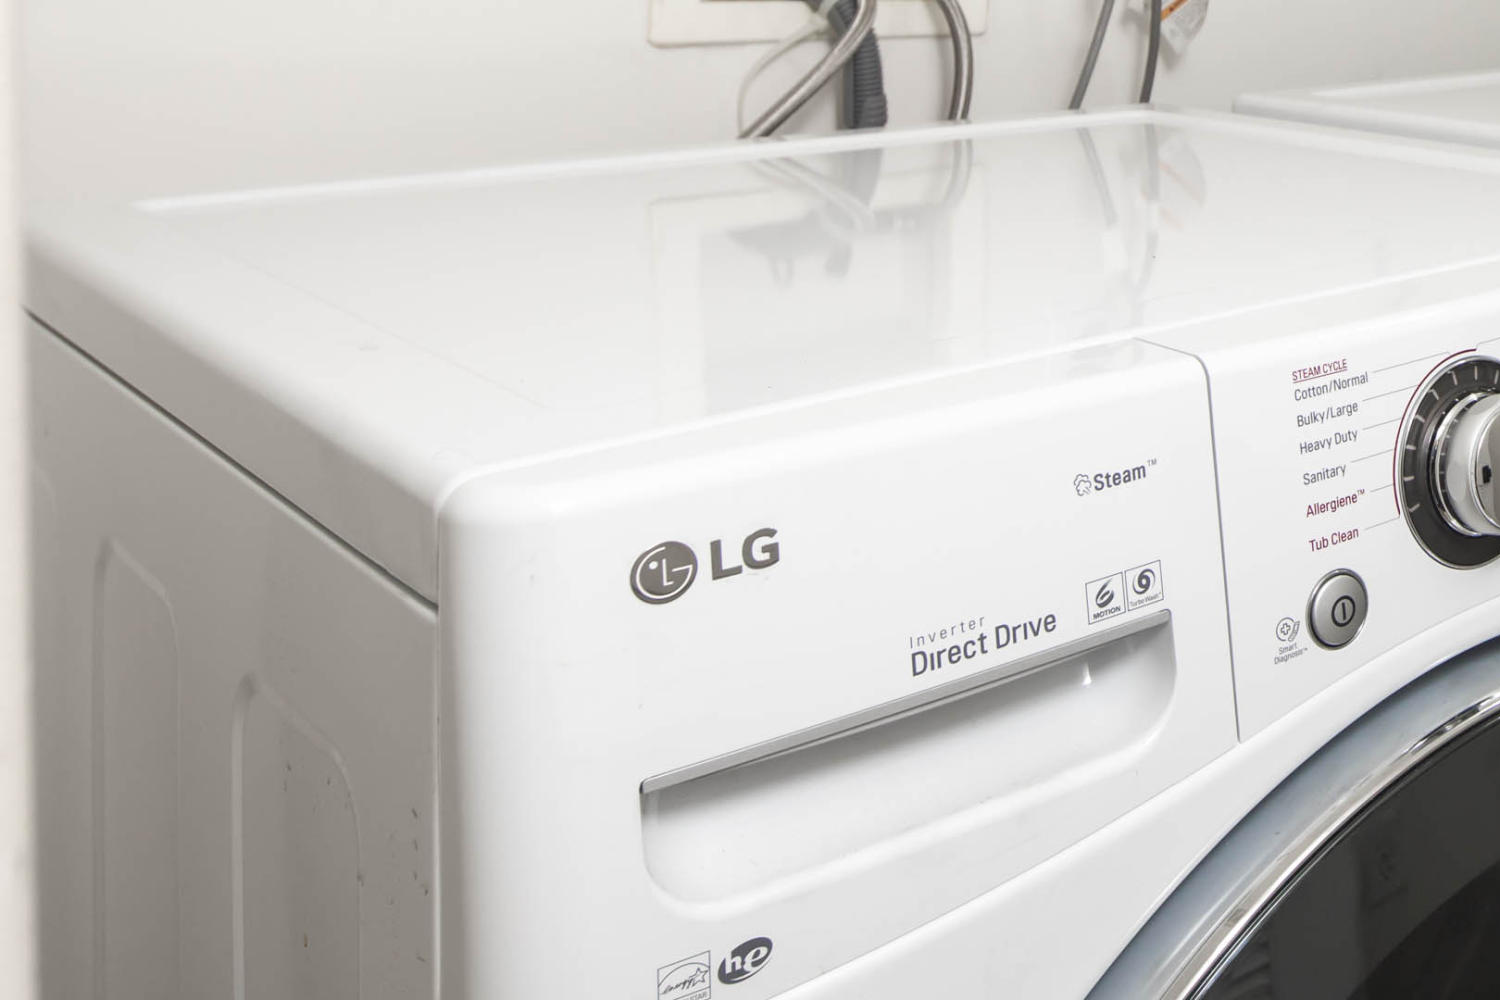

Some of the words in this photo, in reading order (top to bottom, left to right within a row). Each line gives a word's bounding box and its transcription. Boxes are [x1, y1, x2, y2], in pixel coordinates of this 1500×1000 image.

[1292, 365, 1321, 381] STEAM
[1323, 358, 1347, 374] CYCLE
[1294, 371, 1369, 401] Cotton/Normal
[1296, 402, 1359, 428] Bulky/Large
[1299, 436, 1332, 455] Heavy
[1334, 429, 1358, 445] Duty
[1302, 464, 1347, 486] Sanitary
[1308, 536, 1329, 552] Tub
[1330, 528, 1359, 546] Clean
[709, 527, 780, 581] LG
[1093, 606, 1122, 619] MOTION
[909, 616, 985, 649] Inverter
[911, 632, 989, 677] Direct
[995, 613, 1057, 649] Drive
[1279, 642, 1297, 655] Smart
[722, 943, 770, 978] he
